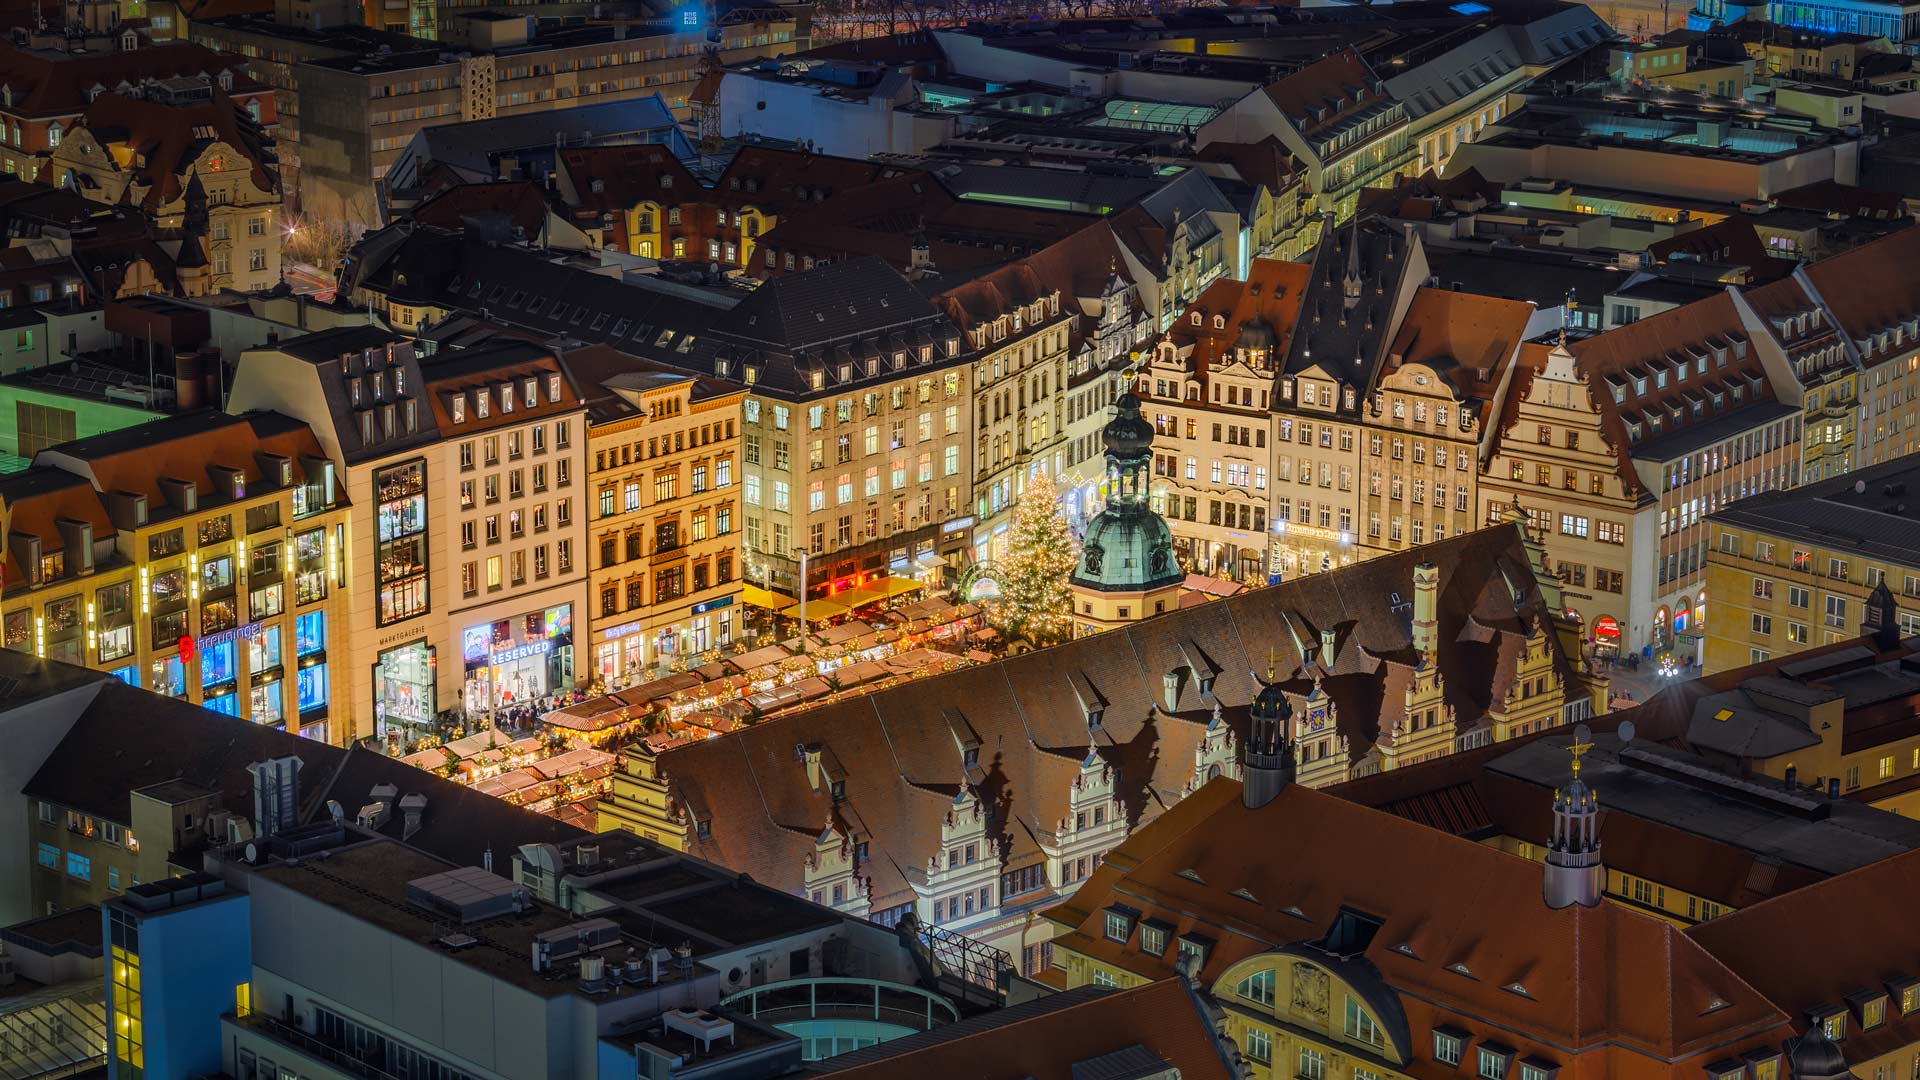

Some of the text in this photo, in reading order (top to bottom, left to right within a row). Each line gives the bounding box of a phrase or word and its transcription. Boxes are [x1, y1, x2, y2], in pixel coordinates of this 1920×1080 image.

[197, 622, 264, 650] breuninger
[379, 626, 425, 645] MARKTGALERIE
[492, 642, 549, 664] RESERVED
